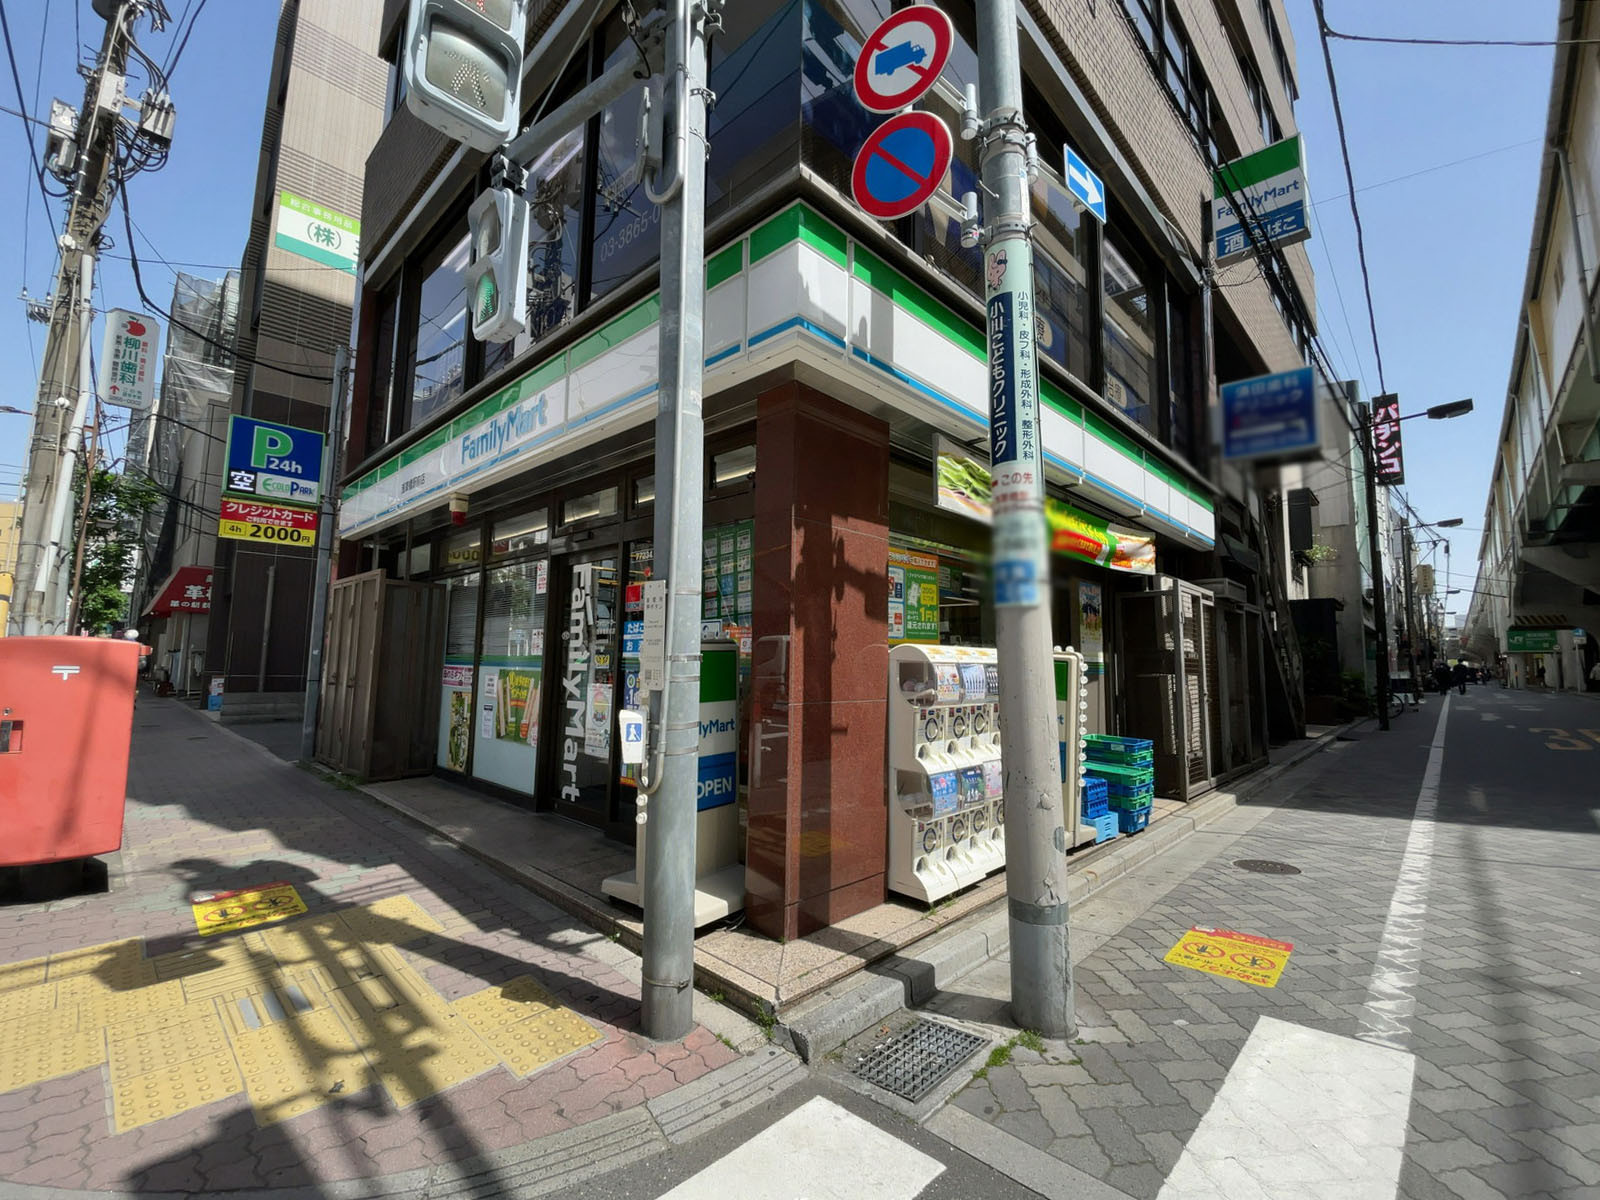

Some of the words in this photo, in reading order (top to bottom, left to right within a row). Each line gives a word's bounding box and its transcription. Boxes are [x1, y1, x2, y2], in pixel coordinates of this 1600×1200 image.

[307, 221, 342, 250] (株)
[1224, 232, 1245, 254] 酒
[118, 336, 141, 387] 柳川歯科
[1017, 290, 1035, 461] 小児科・皮フ科・形成外科・整形外科
[990, 301, 1008, 459] 小川こどもクリニック
[251, 425, 294, 469] P
[460, 393, 549, 465] FamilyMart
[1374, 403, 1401, 474] パチンコ
[229, 470, 255, 492] 空
[268, 457, 302, 474] 24h
[1001, 471, 1033, 486] この先
[225, 502, 314, 523] クレジットカード
[228, 524, 242, 533] 4h
[249, 523, 311, 543] 2000円
[561, 563, 593, 803] FamilyMart
